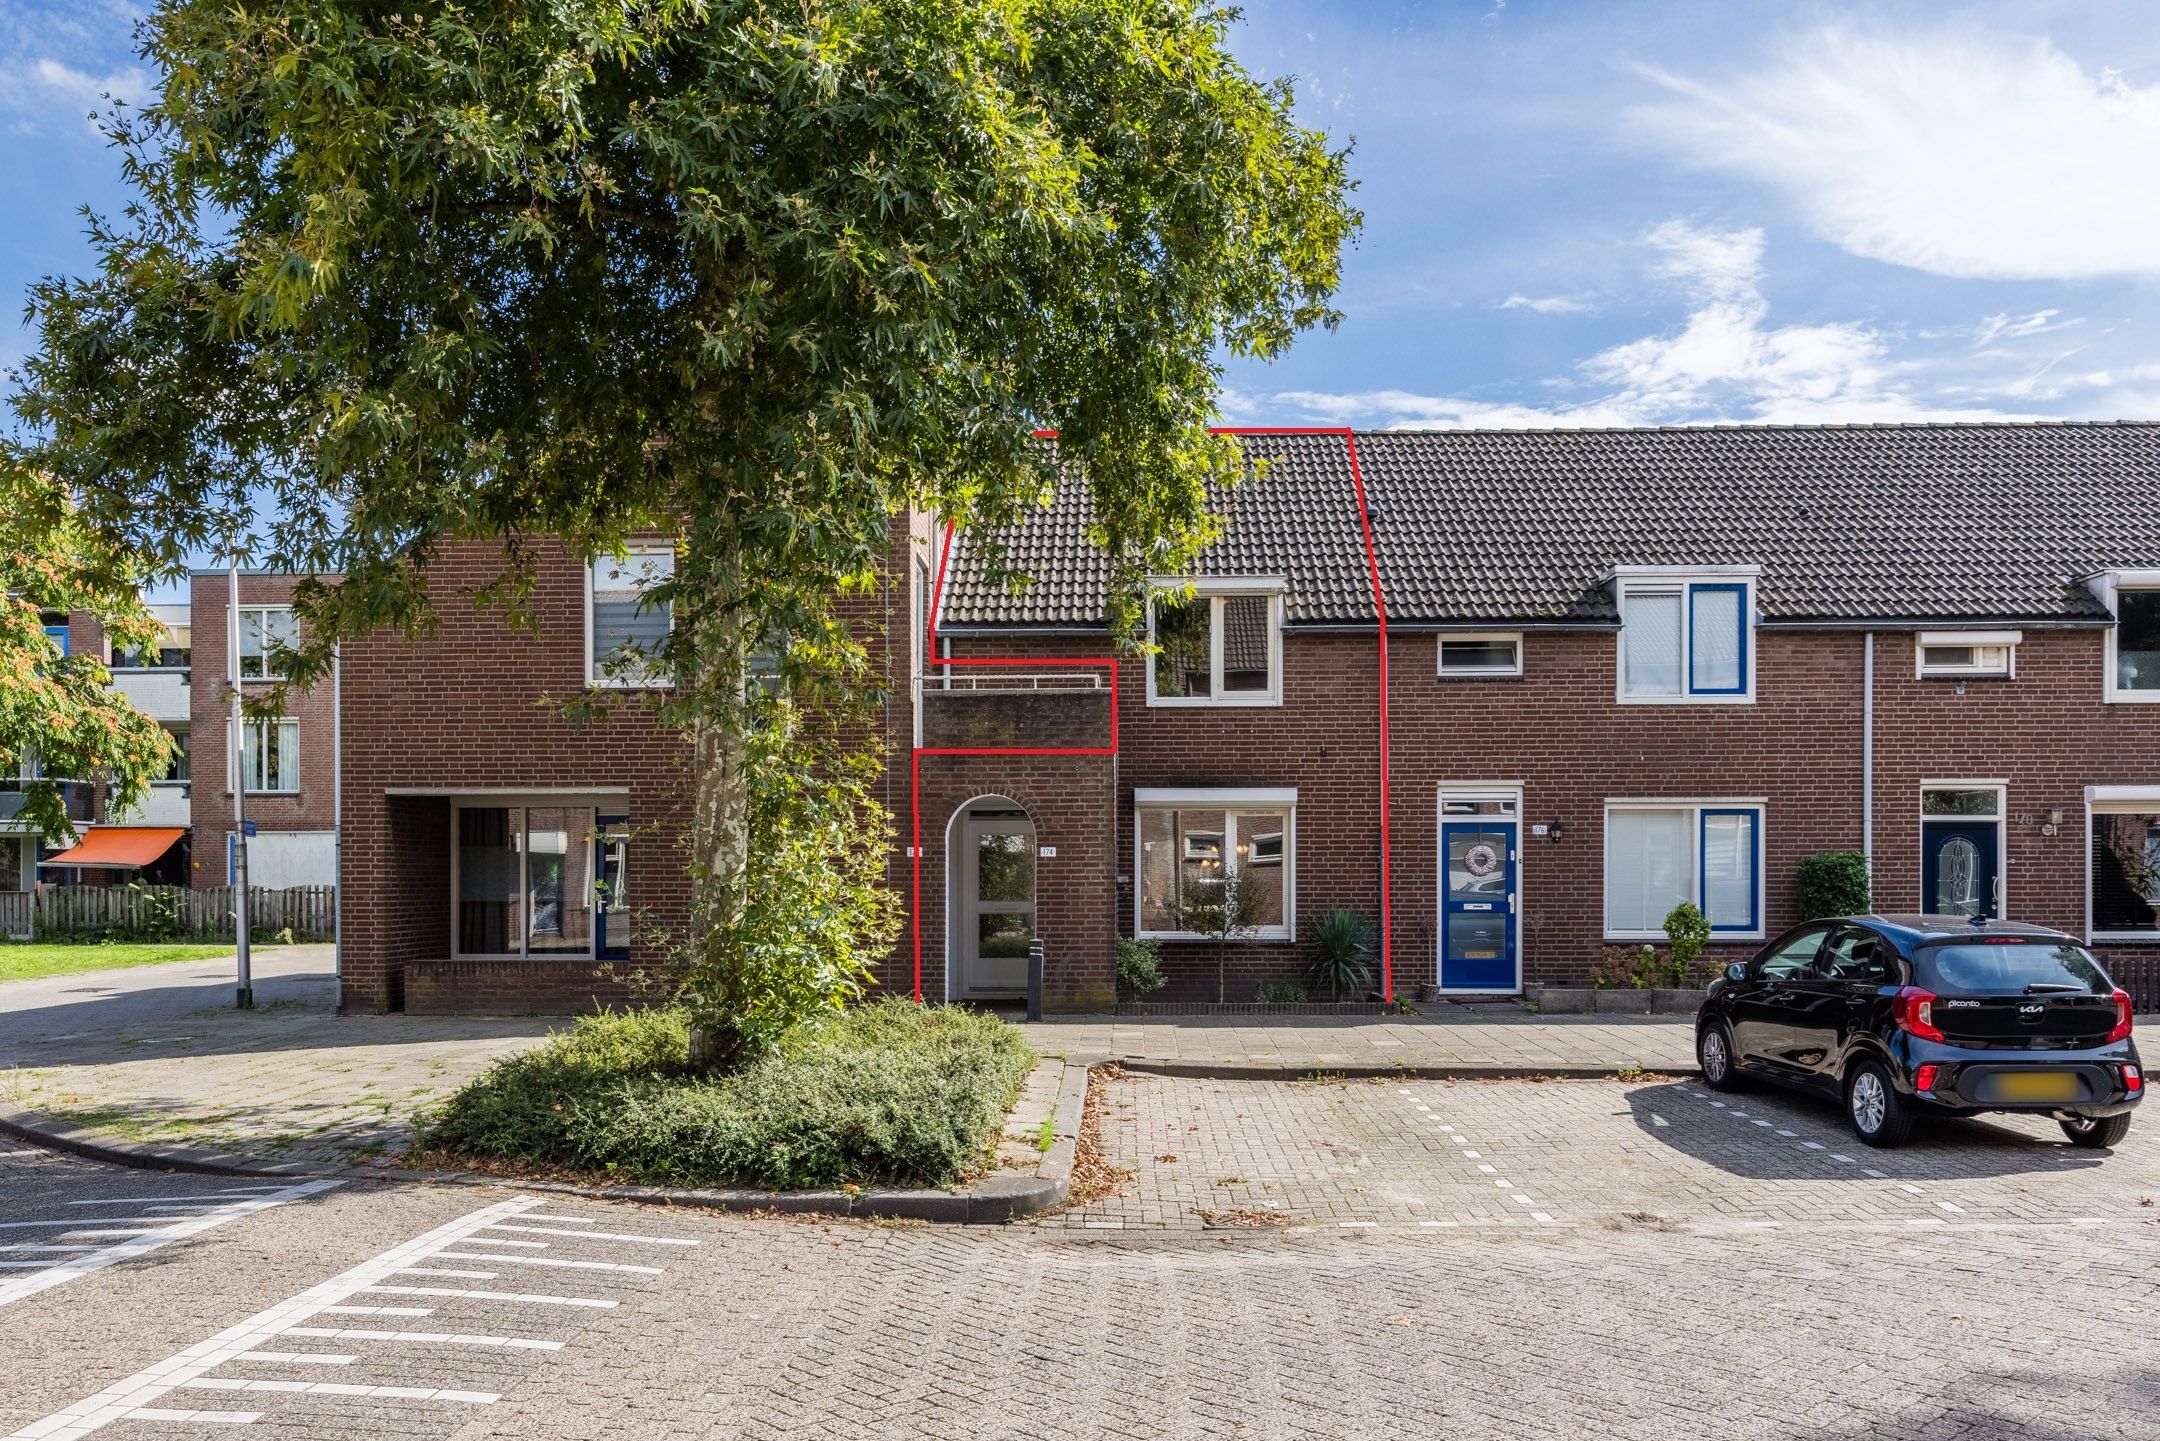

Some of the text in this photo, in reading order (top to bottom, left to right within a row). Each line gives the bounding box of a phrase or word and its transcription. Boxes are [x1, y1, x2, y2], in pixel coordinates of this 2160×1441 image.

[1043, 848, 1053, 856] 174
[1948, 1000, 1980, 1008] picanto
[2020, 1005, 2043, 1013] KIA
